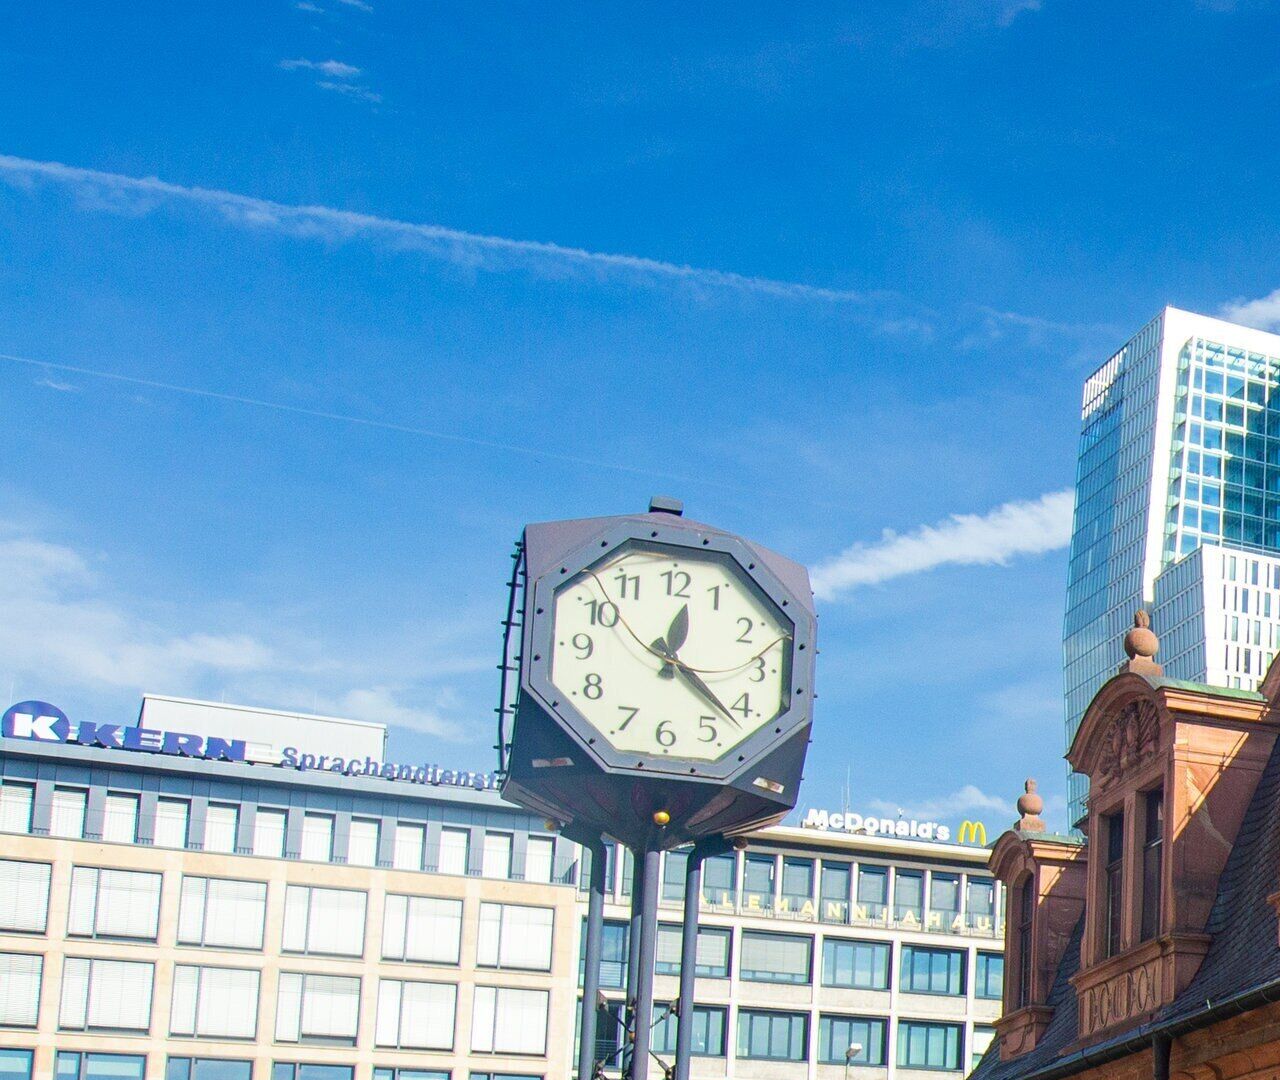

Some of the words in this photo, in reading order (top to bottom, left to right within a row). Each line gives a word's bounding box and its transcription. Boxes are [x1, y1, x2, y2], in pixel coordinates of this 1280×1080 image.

[614, 572, 641, 601] 11
[660, 570, 692, 599] 12
[706, 584, 722, 612] 1
[583, 599, 621, 628] 10
[735, 616, 754, 644] 2
[571, 632, 595, 661] 9
[748, 655, 767, 683] 3
[582, 672, 604, 700] 8
[617, 705, 641, 732] 7
[730, 692, 754, 718] 4
[77, 720, 247, 761] KERN
[654, 719, 678, 747] 6
[696, 715, 719, 743] 5
[806, 808, 951, 842] McDonald's
